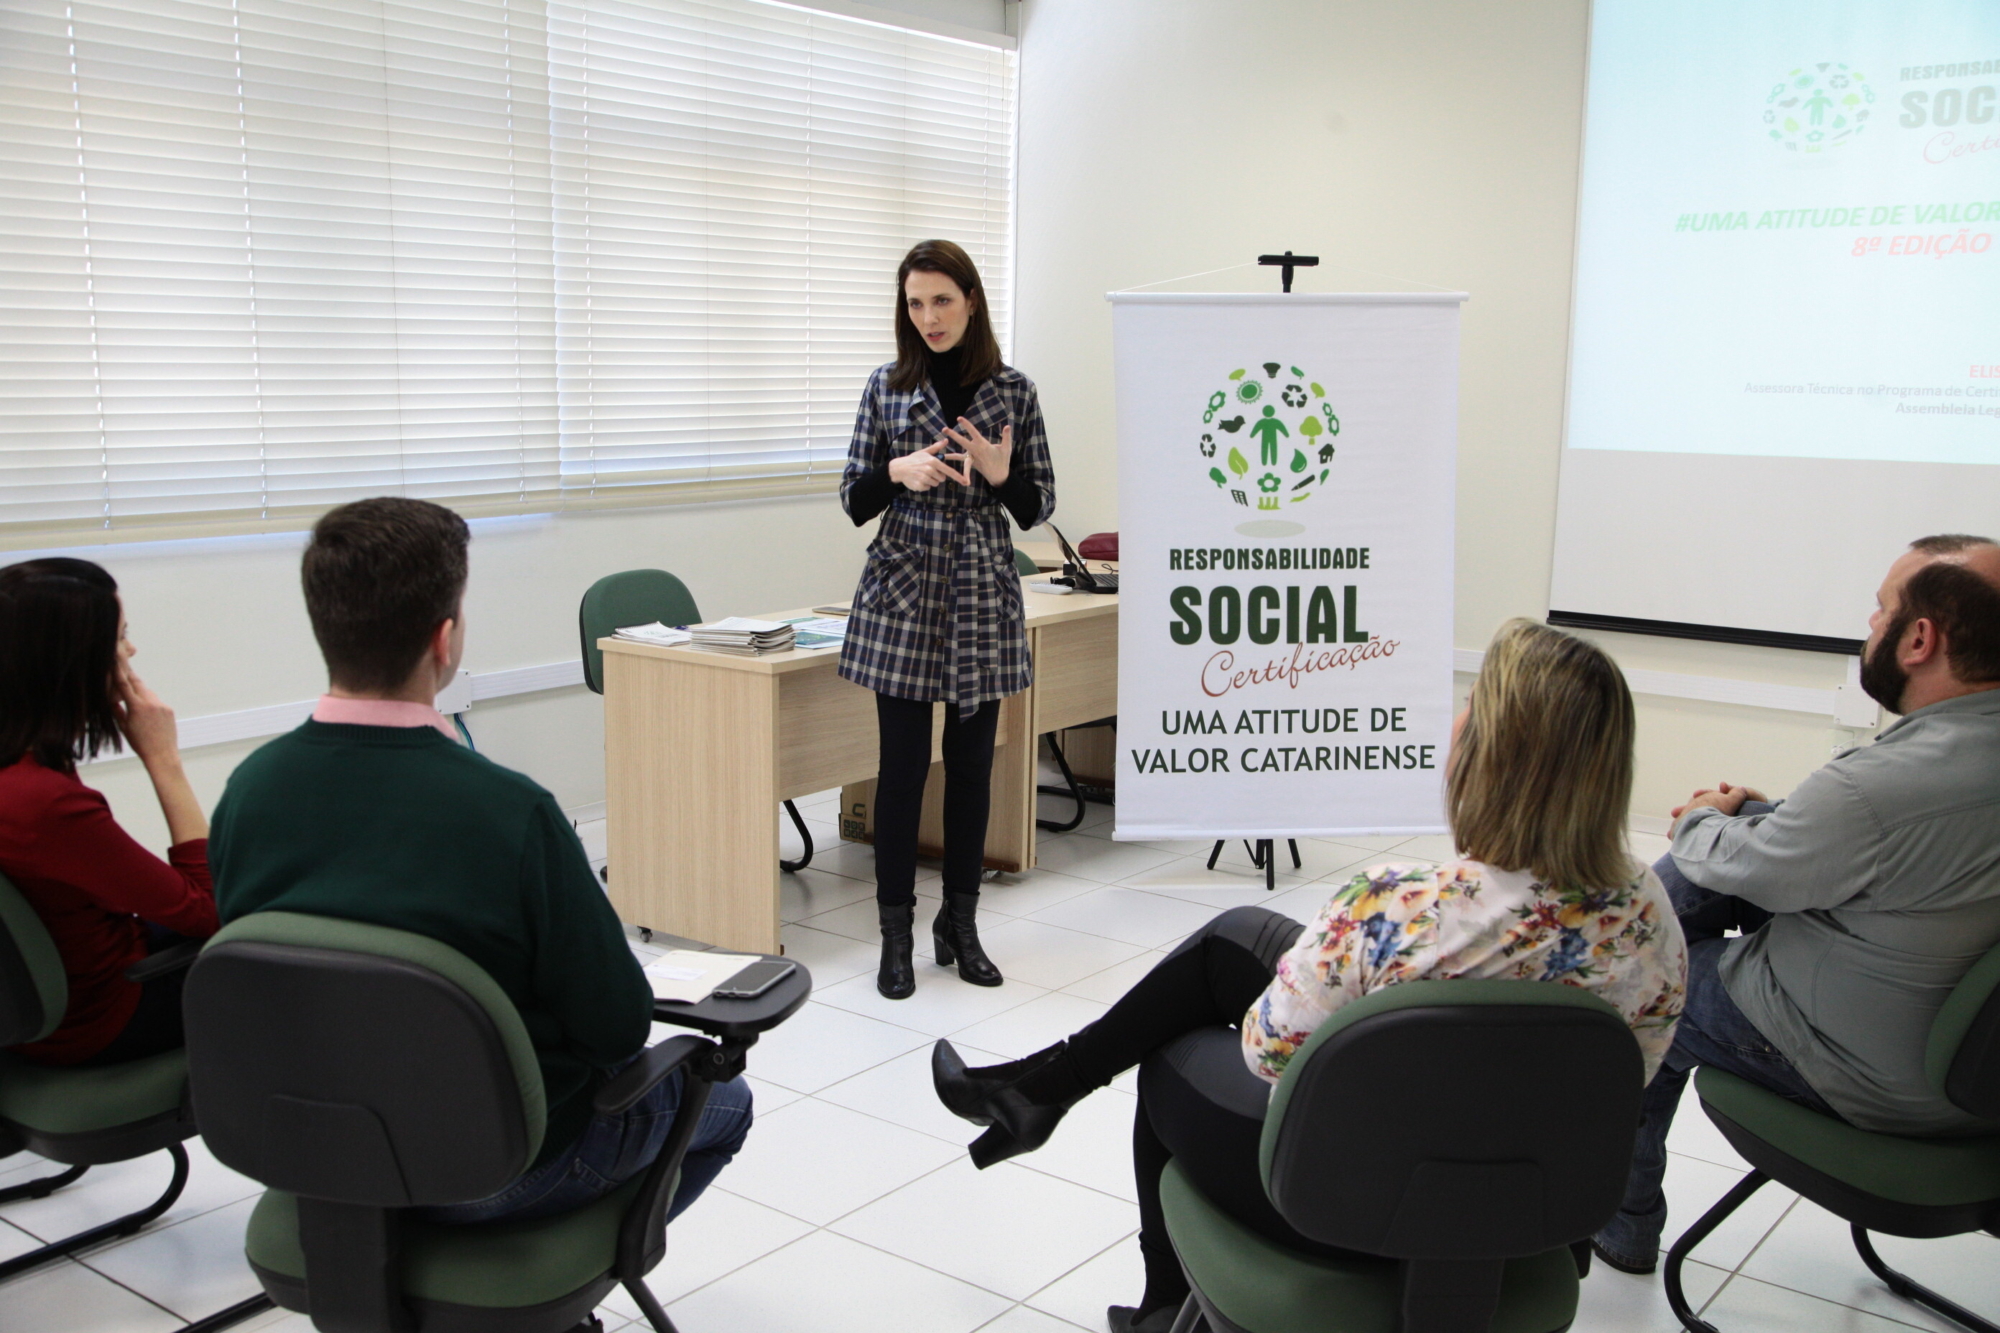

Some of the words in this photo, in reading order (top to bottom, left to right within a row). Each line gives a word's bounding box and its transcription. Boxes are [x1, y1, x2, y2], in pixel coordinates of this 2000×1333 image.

[1899, 85, 2000, 129] SOC
[1674, 210, 1750, 232] #UMA
[1755, 206, 1865, 231] ATITUDE
[1869, 204, 1907, 227] DE
[1914, 201, 2000, 225] VALOR
[1887, 228, 1992, 260] EDIÇÃO
[1744, 382, 1804, 394] Assessora
[1807, 382, 1854, 395] Técnica
[1857, 386, 1874, 396] no
[1877, 384, 1942, 398] Programa
[1944, 385, 1962, 397] de
[1965, 385, 2000, 398] Certi
[1895, 402, 1976, 415] Assembleia
[1169, 547, 1370, 571] RESPONSABILIDADE
[1169, 585, 1369, 645] SOCIAL
[1201, 635, 1400, 698] Certificação
[1162, 709, 1228, 735] UMA
[1234, 708, 1359, 735] ATITUDE
[1370, 707, 1407, 732] DE
[1131, 748, 1230, 774] VALOR
[1240, 745, 1436, 773] CATARINENSE
